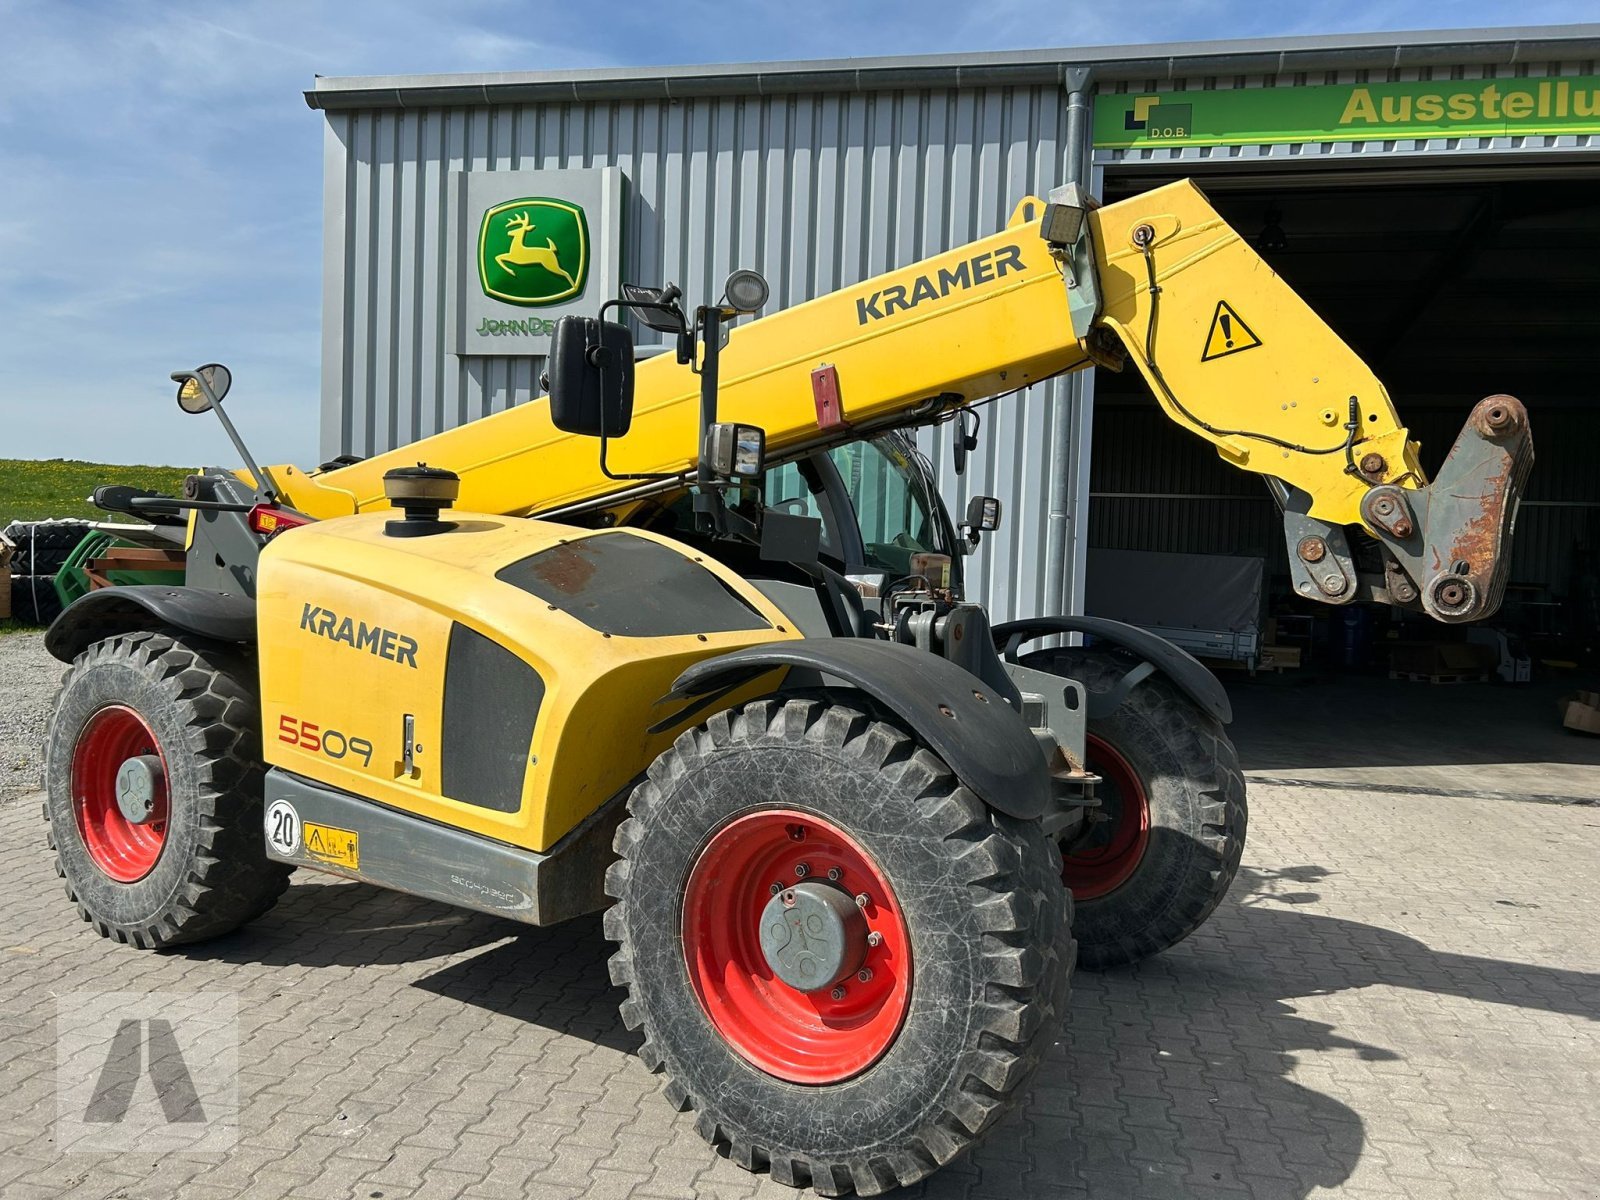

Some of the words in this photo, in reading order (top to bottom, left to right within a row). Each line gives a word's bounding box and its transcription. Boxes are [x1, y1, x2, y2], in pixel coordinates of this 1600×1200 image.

[1151, 127, 1188, 138] D.O.B.
[856, 244, 1027, 325] KRAMER
[300, 602, 418, 669] KRAMER
[278, 714, 373, 768] 5509
[273, 809, 294, 847] 20
